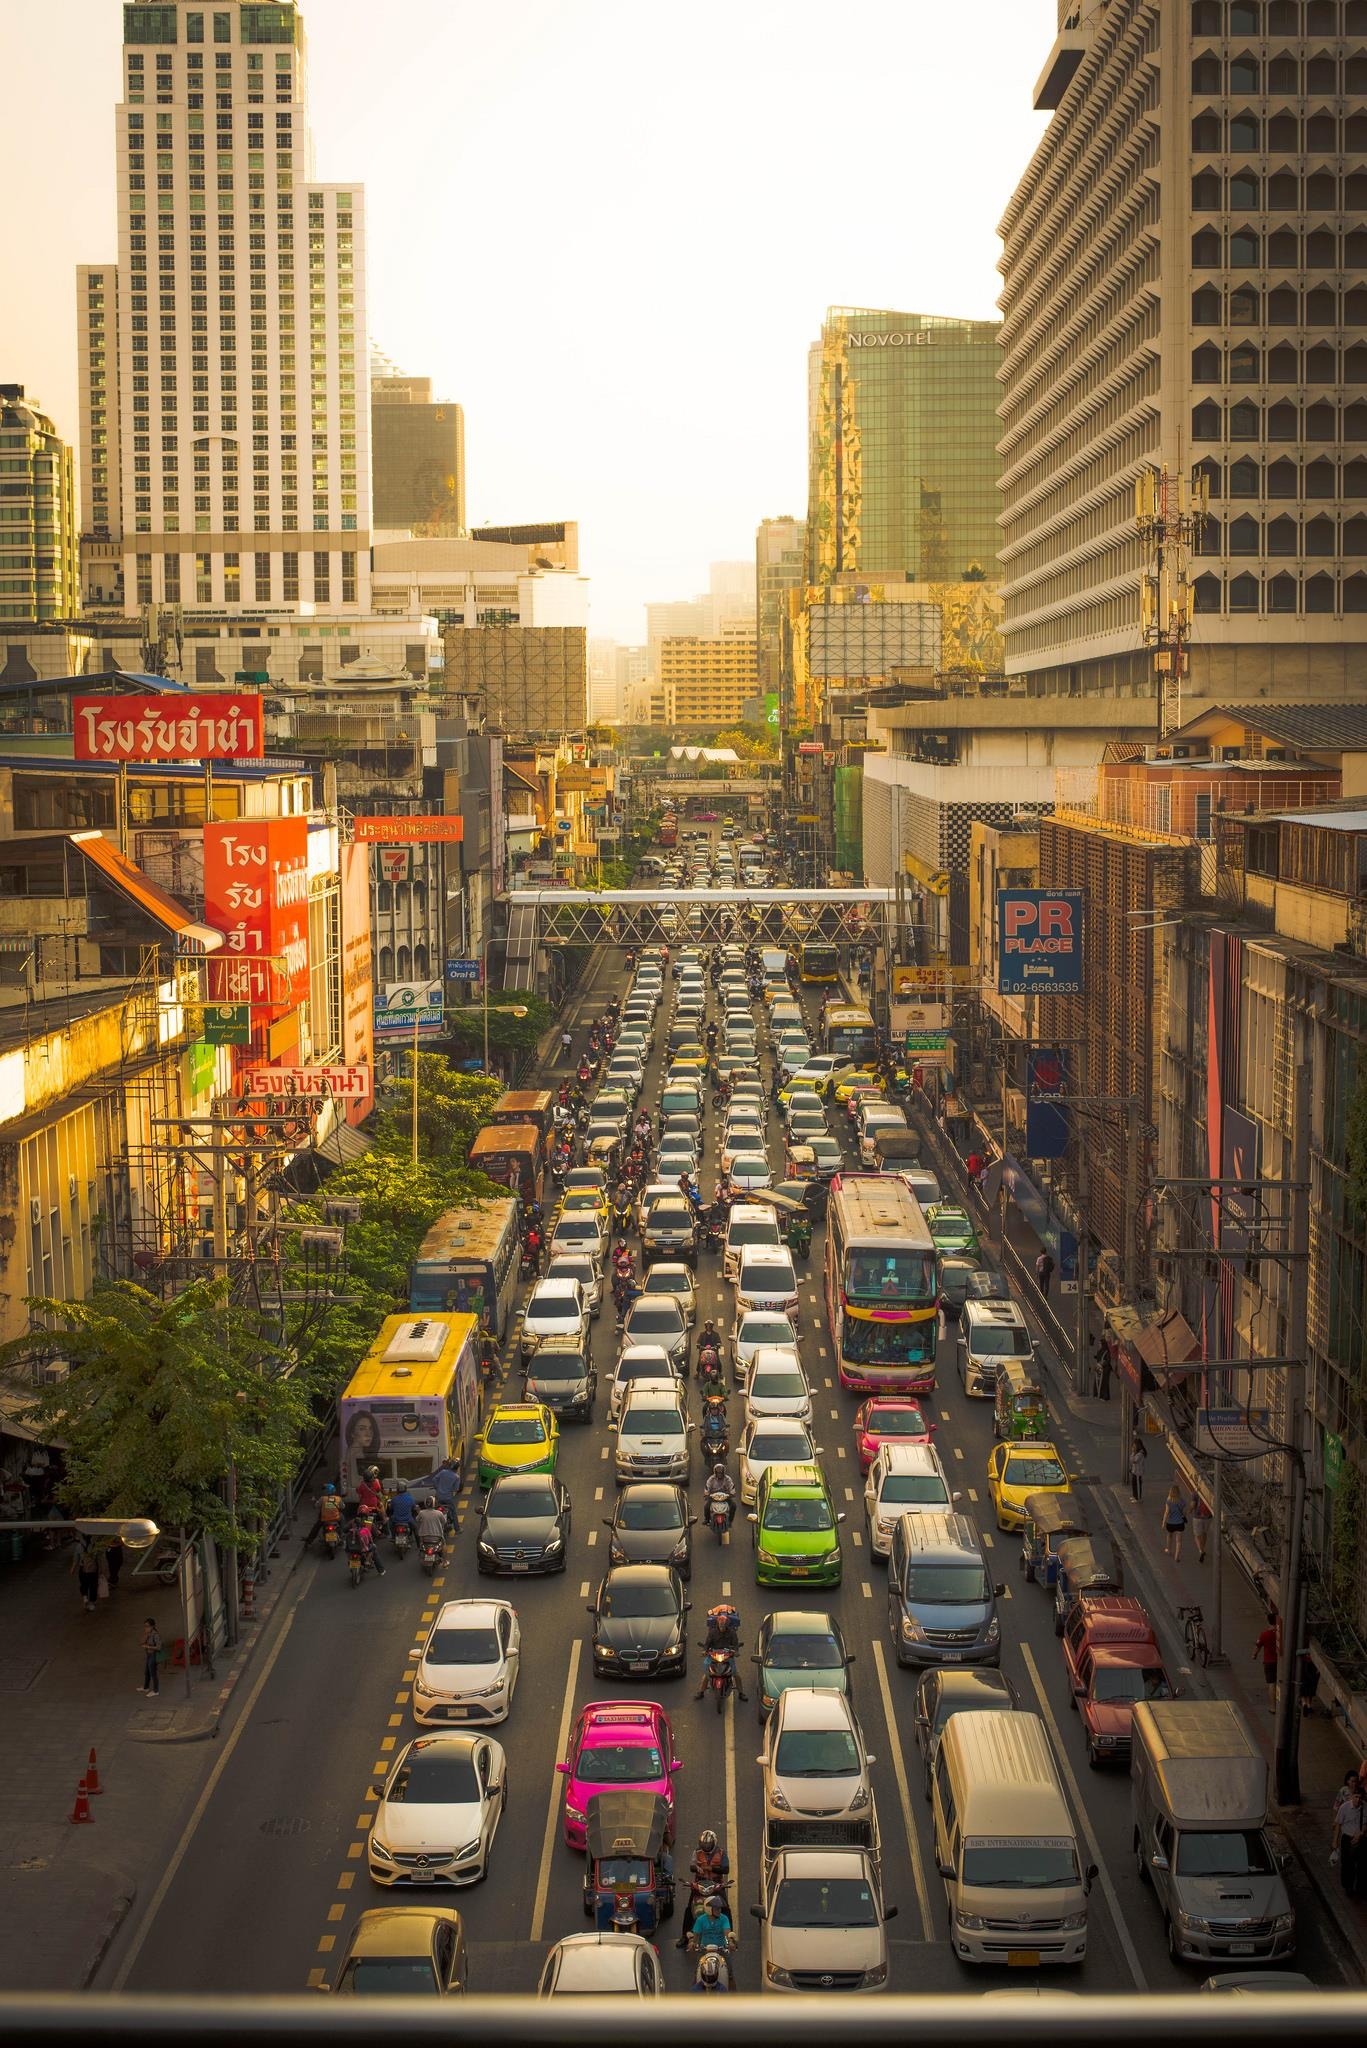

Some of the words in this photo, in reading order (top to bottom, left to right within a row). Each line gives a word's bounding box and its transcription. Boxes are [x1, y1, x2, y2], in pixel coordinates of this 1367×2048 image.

[848, 330, 937, 348] NOVOTEL
[79, 705, 255, 754] โรงรับจำนำ
[220, 836, 267, 867] โรง
[224, 881, 262, 909] รับ
[1005, 901, 1074, 936] PR
[227, 921, 263, 951] จำ
[1005, 938, 1073, 953] PLACE
[450, 971, 476, 979] Oral-B
[1013, 983, 1079, 992] 02-6563535
[987, 1840, 1040, 1848] INTERNATIONAL
[1042, 1840, 1070, 1848] SCHOOL
